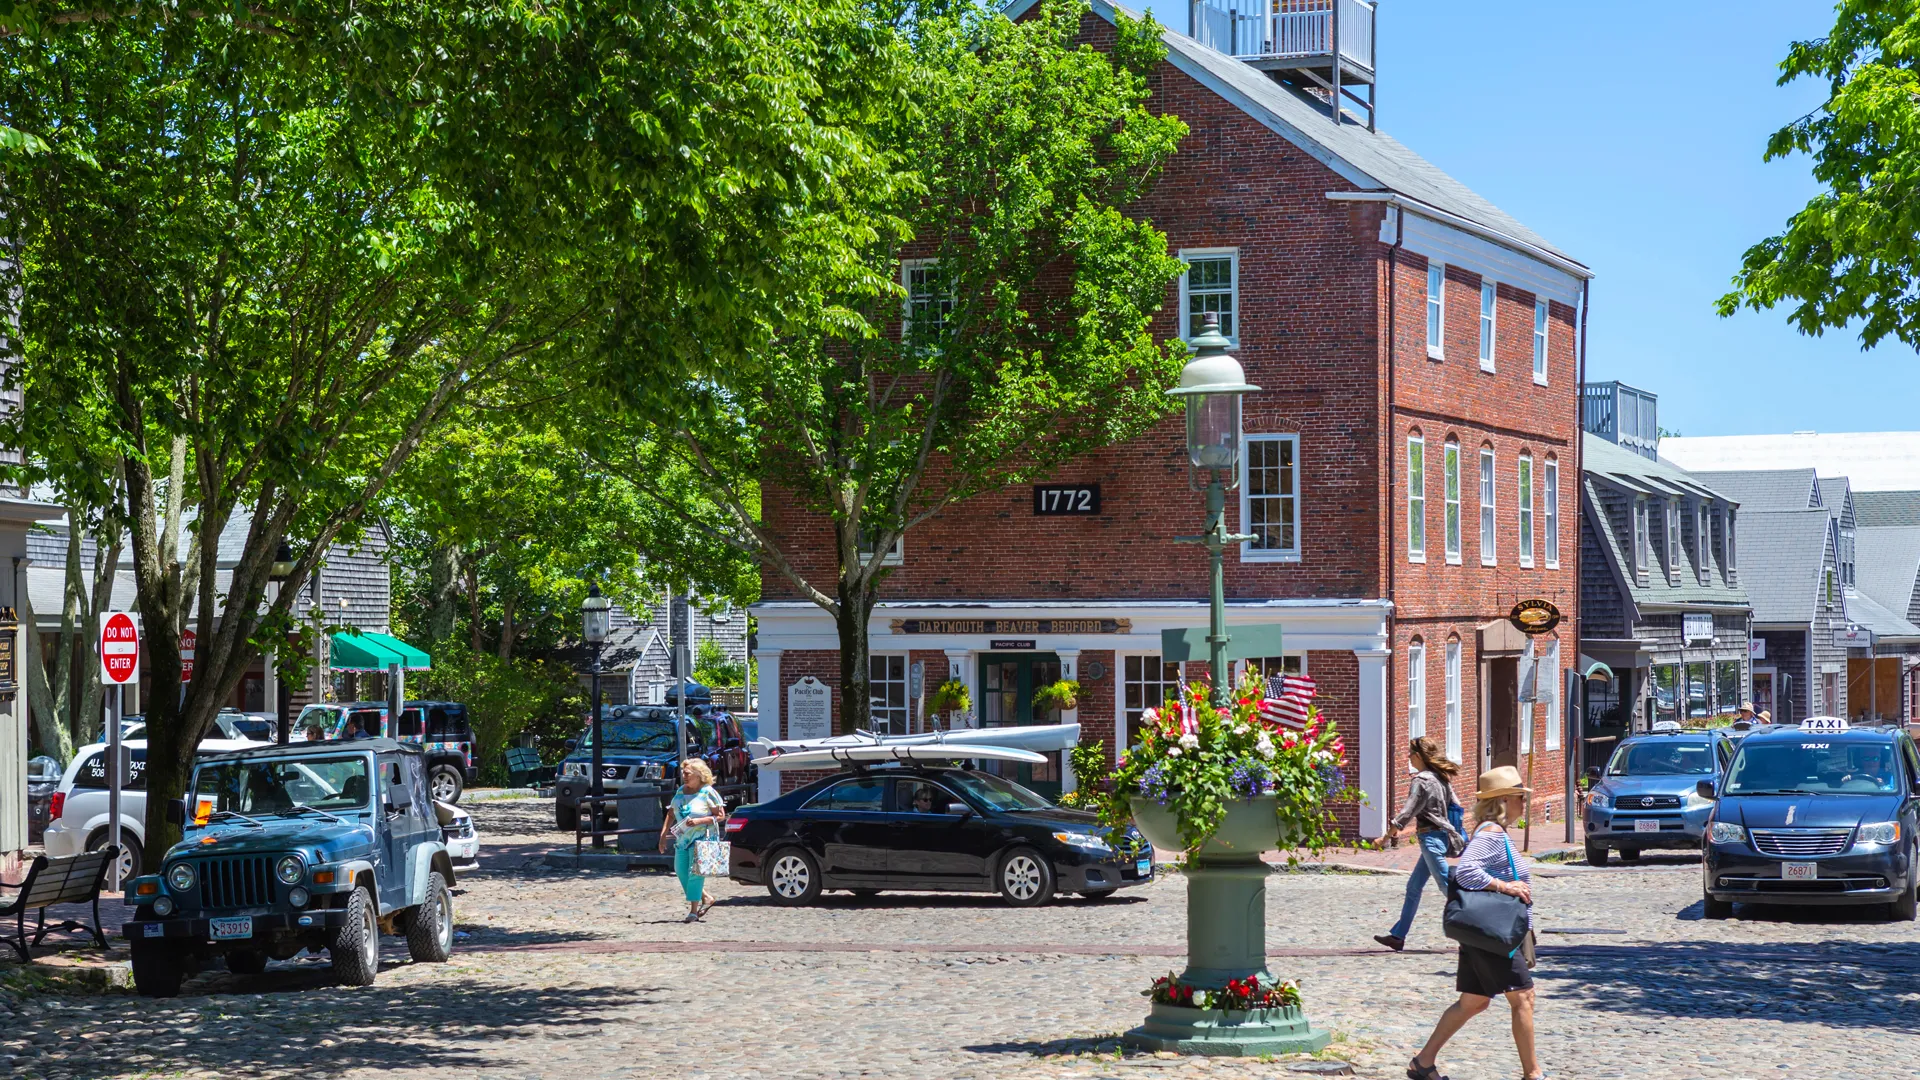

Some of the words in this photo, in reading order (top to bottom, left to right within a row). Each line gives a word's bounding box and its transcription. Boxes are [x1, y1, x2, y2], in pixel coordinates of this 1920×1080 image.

[1041, 489, 1092, 511] 1772
[1518, 601, 1552, 611] SYLVIA
[106, 627, 118, 638] DO
[120, 627, 133, 638] NOT
[918, 621, 985, 633] DARTMOUTH
[995, 621, 1039, 633] BEAVER
[1051, 621, 1102, 633] BEDFORD
[110, 658, 131, 669] ENTER
[1806, 720, 1841, 728] TAXI
[88, 758, 101, 767] ALL
[1788, 866, 1812, 876] 26871
[226, 922, 250, 934] 3919
